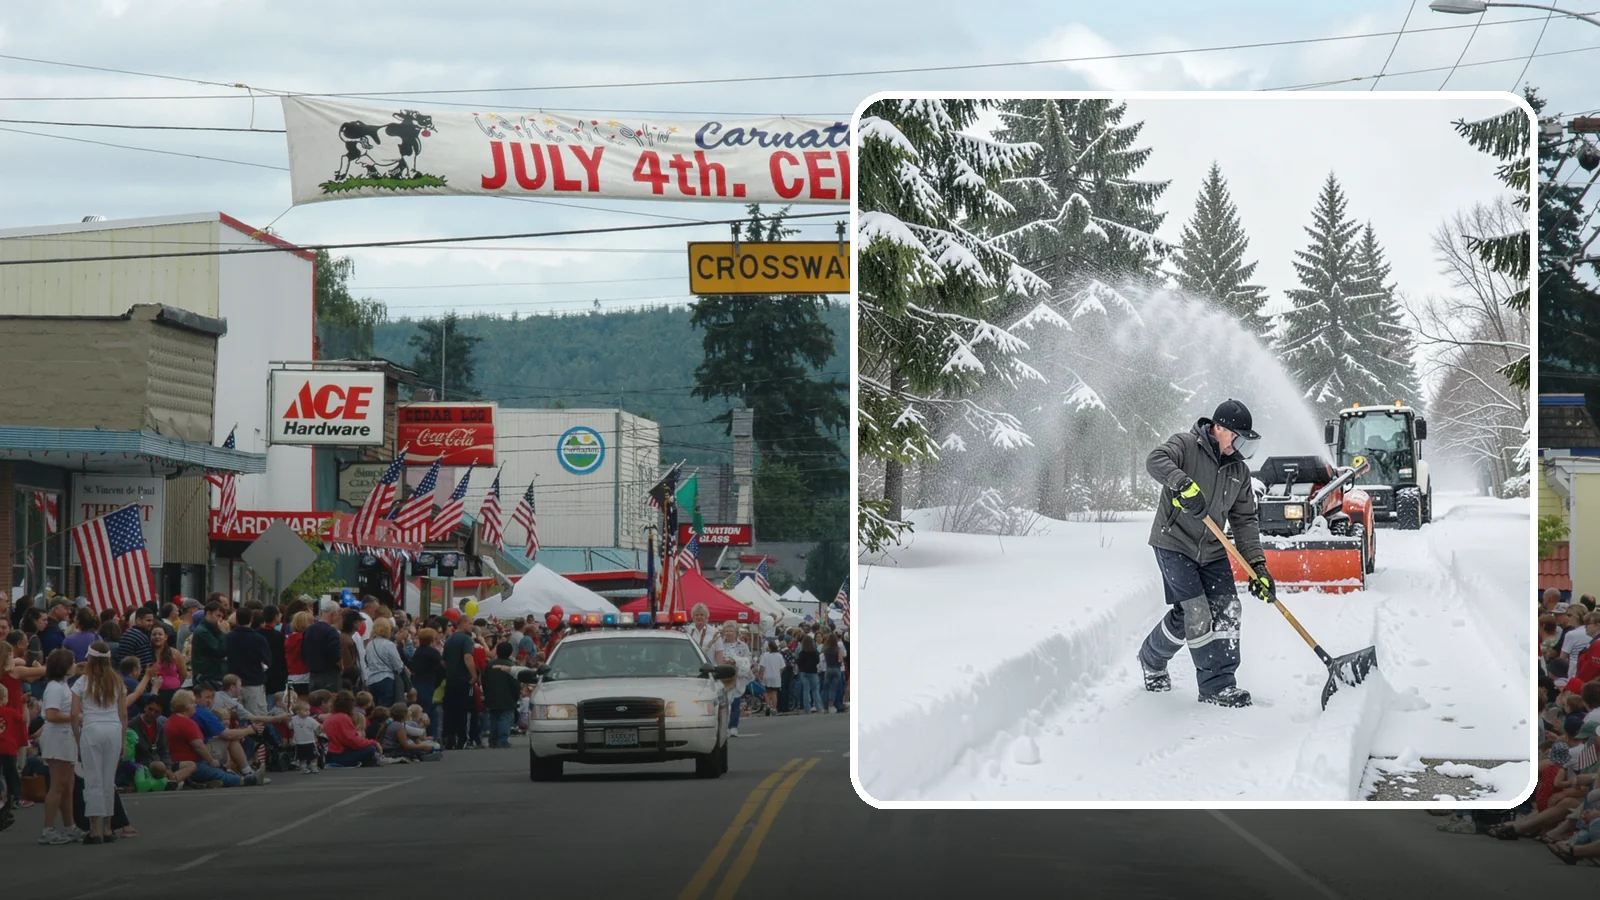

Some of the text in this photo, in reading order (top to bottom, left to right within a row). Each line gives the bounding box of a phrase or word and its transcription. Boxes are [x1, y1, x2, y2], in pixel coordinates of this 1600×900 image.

[481, 140, 605, 193] JULY
[632, 149, 747, 198] 4th.
[696, 254, 850, 280] CROSSWA
[282, 379, 374, 420] ACE
[405, 408, 485, 422] CEDAR LOG
[283, 421, 371, 437] Hardware
[416, 428, 478, 447] Coca-Cola
[353, 467, 387, 480] Simpl
[83, 485, 155, 495] St. Vincent de Paul
[80, 503, 154, 522] THT
[212, 516, 331, 535] HARDARE
[688, 526, 741, 535] CRNATION
[699, 535, 730, 543] GLASS
